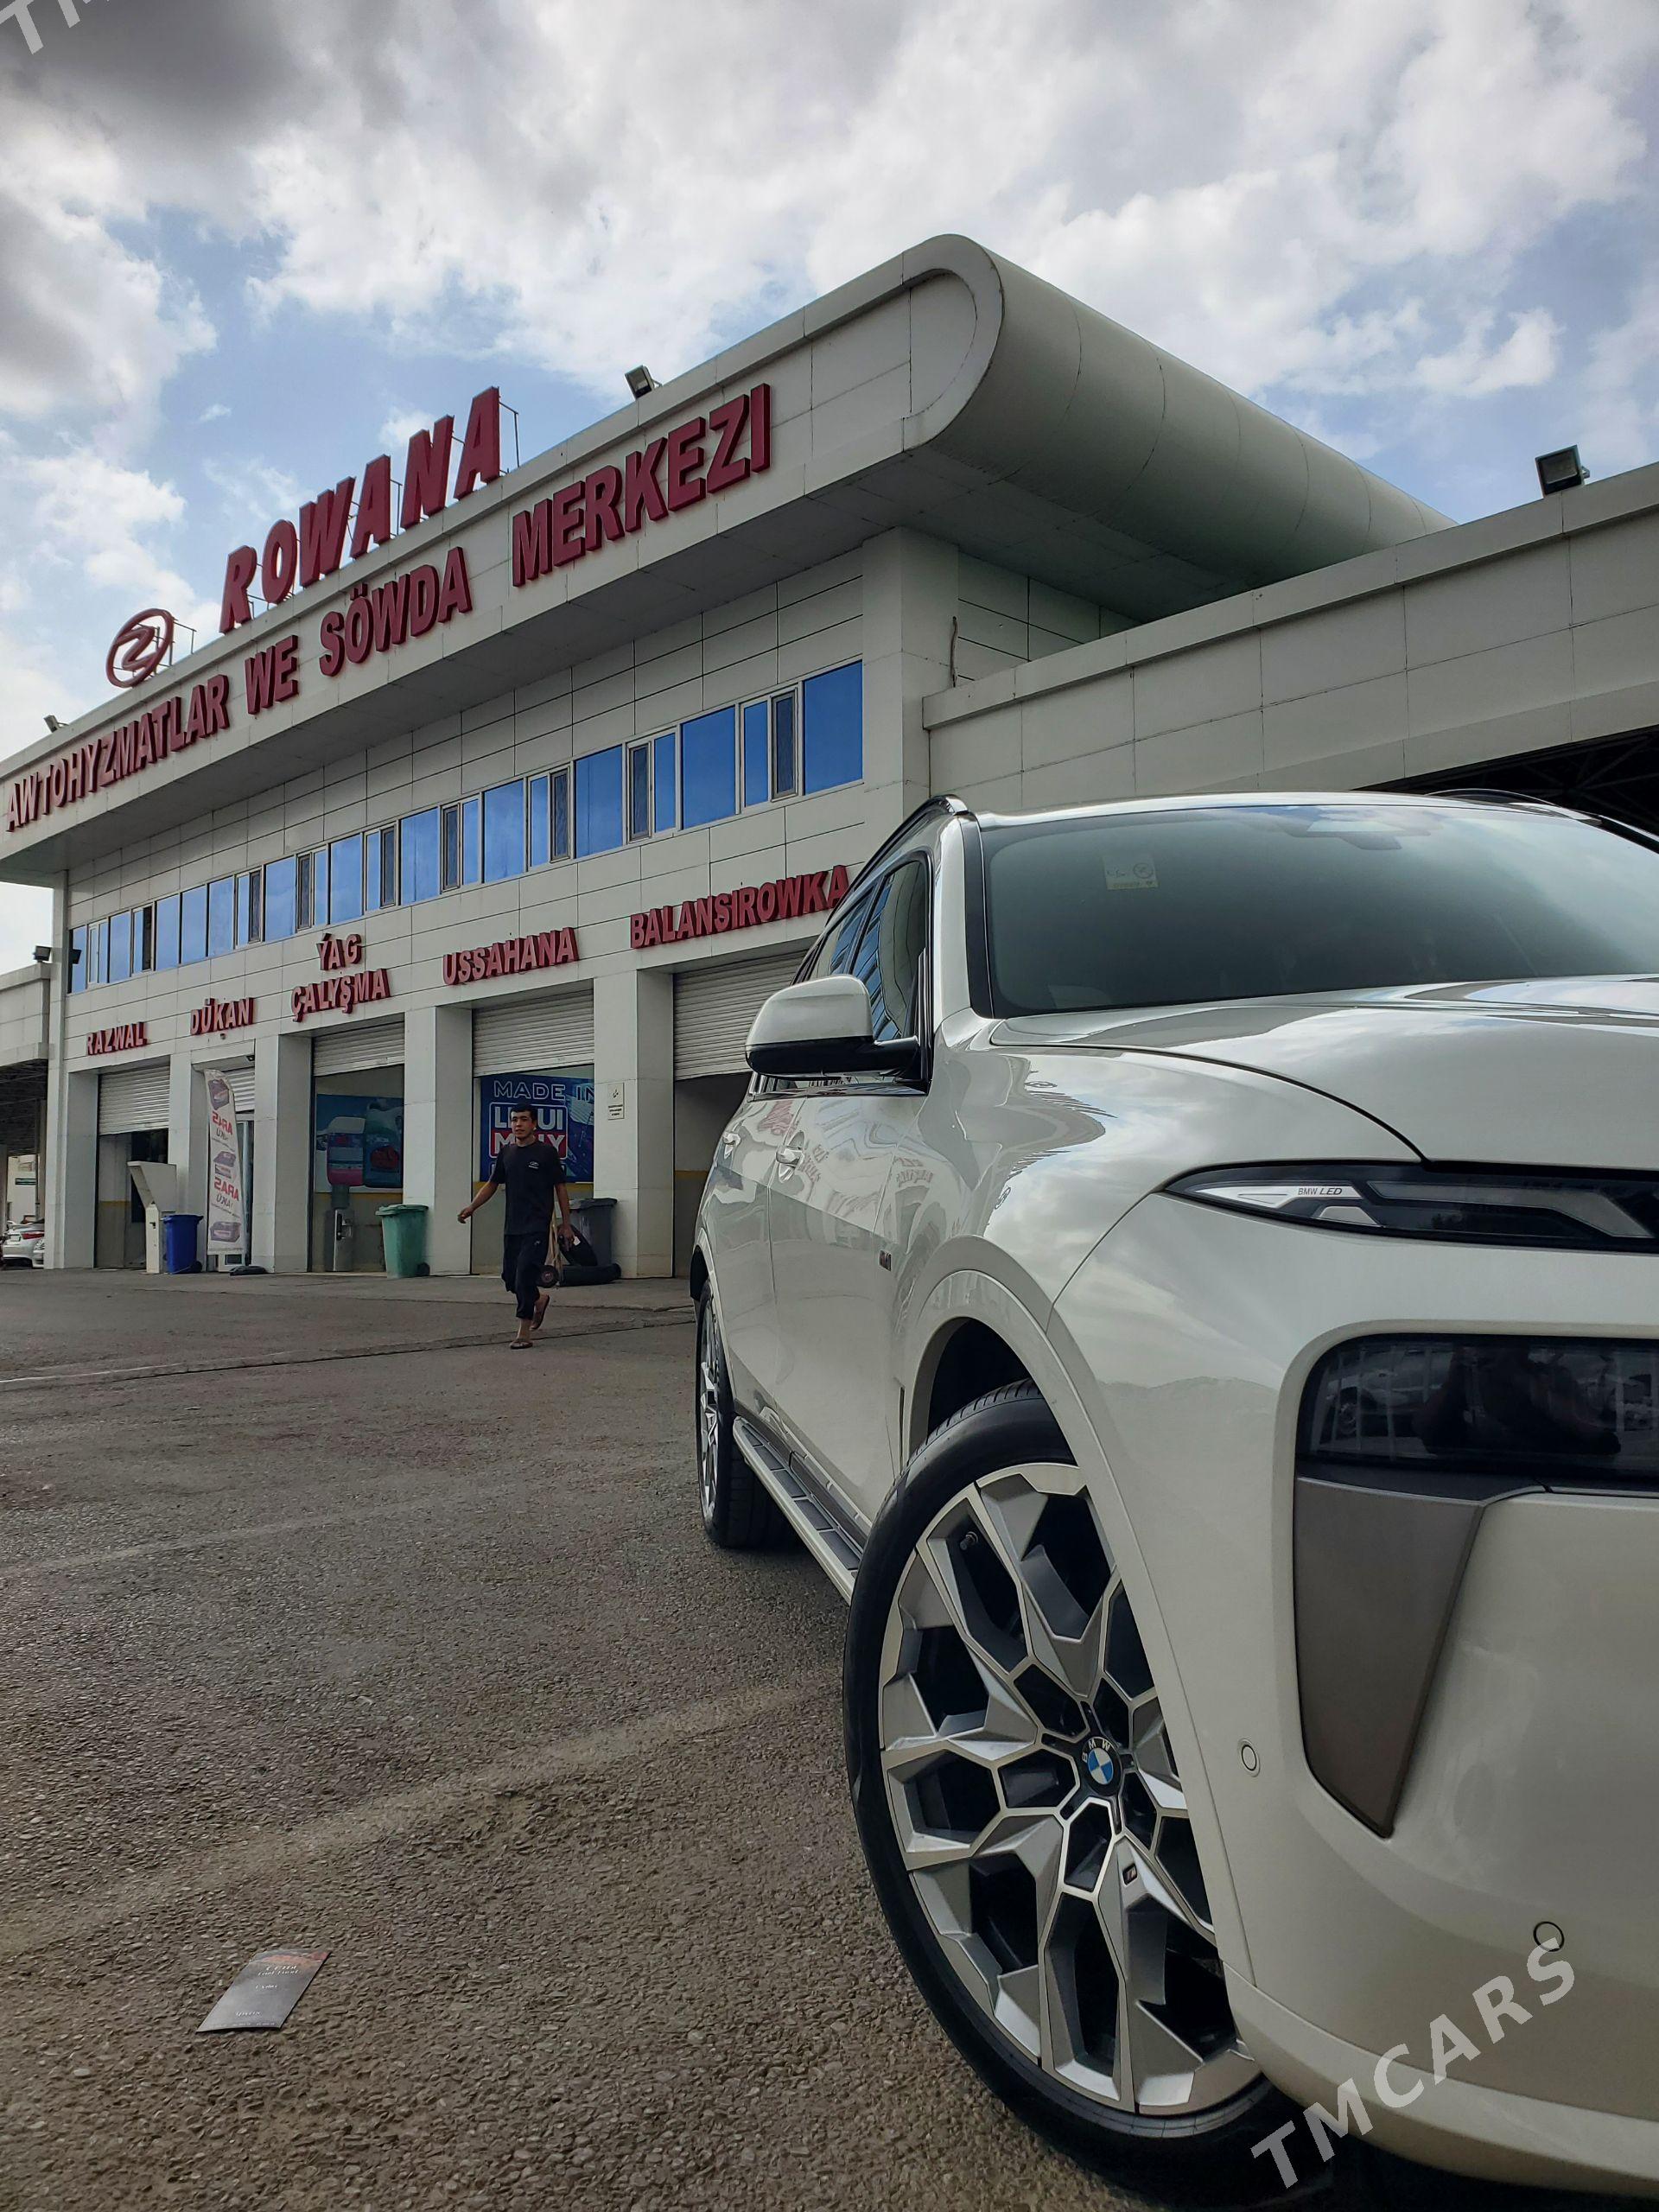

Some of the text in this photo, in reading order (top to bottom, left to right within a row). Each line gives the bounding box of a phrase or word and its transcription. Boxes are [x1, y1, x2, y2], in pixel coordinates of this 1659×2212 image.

[219, 385, 500, 634] ROWANA
[7, 383, 771, 833] AWTOHYZMATLAR WE SÖWDA MERKEZI
[630, 865, 849, 949] BALANSIROWKA
[316, 933, 361, 970] ÝAG
[442, 927, 579, 985] USSAHANA
[291, 968, 391, 1022] ÇALYŞMA
[190, 997, 256, 1035] DÜKAN
[86, 1021, 148, 1055] RAZWAL
[493, 1080, 594, 1102] MADE IN
[494, 1106, 563, 1130] LUI
[494, 1133, 565, 1154] MY
[1298, 1187, 1343, 1196] BMW LED
[1082, 1738, 1111, 1764] BMW
